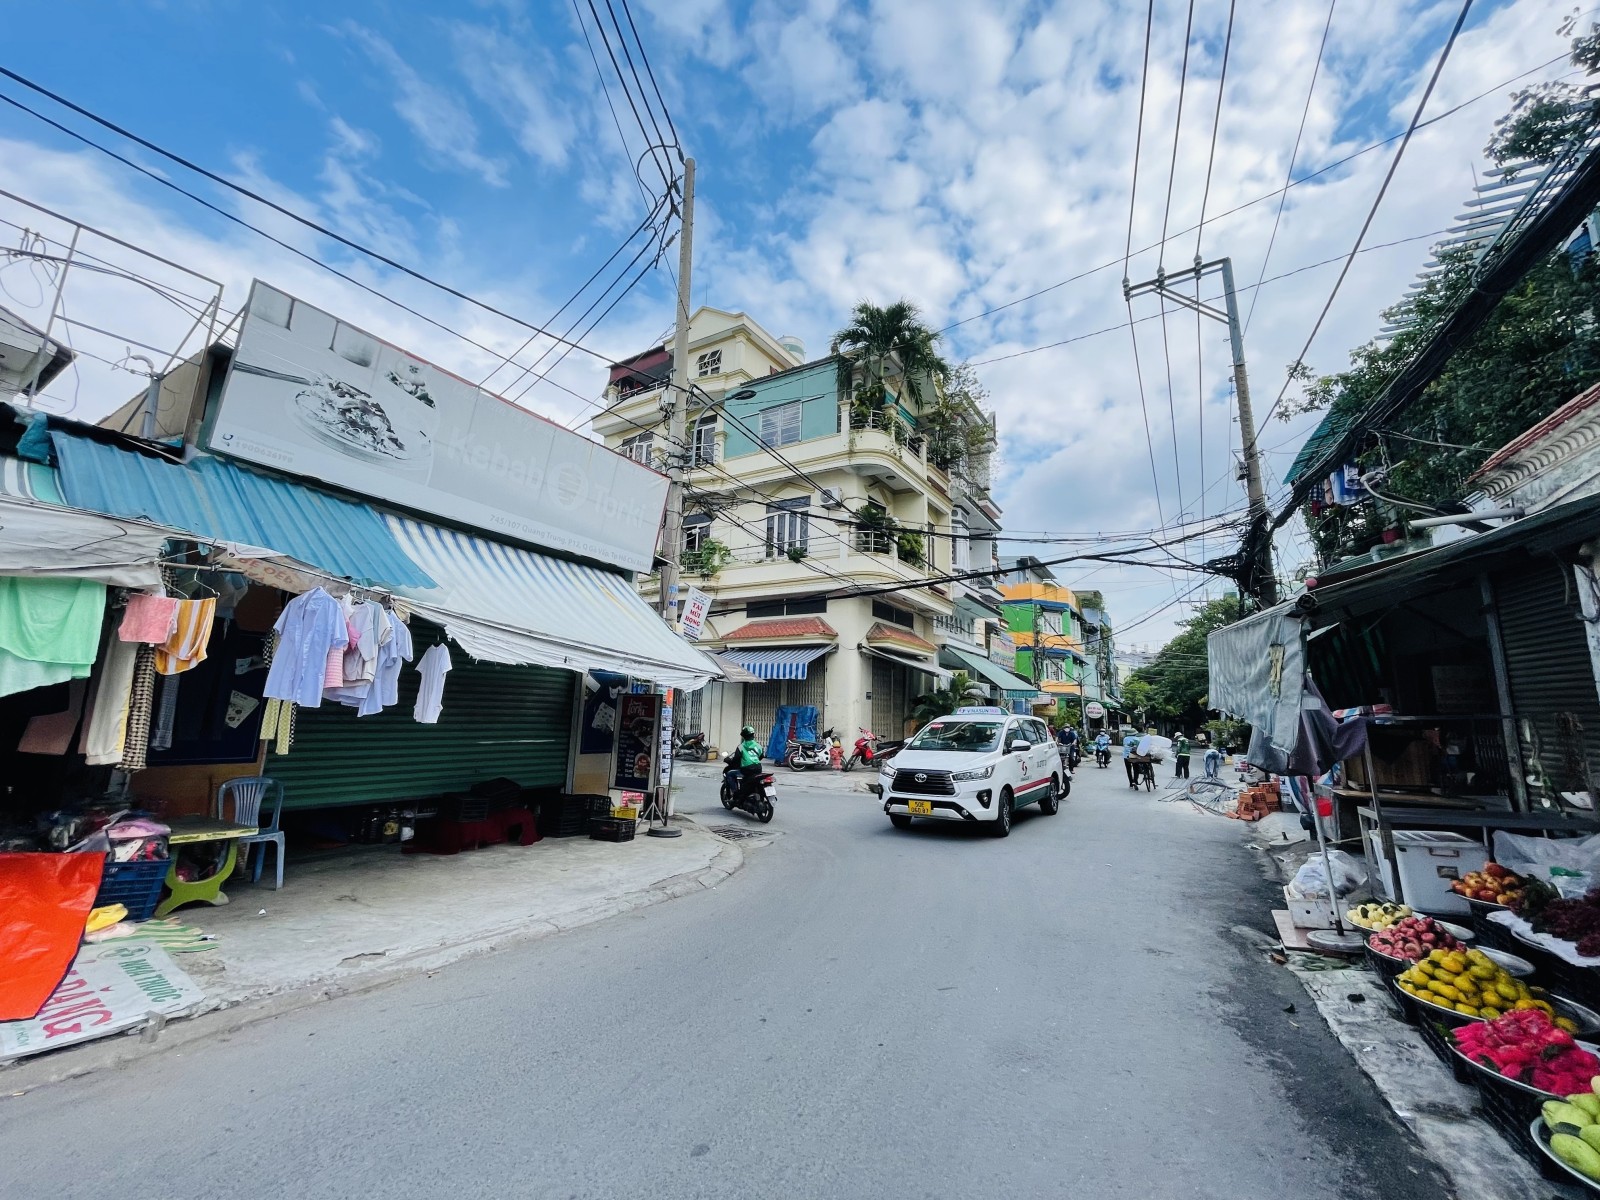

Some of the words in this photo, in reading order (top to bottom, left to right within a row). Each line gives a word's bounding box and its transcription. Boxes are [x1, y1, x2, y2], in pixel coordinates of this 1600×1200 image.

[447, 429, 545, 489] Kebab
[521, 524, 546, 539] Quang
[692, 602, 703, 612] TAI
